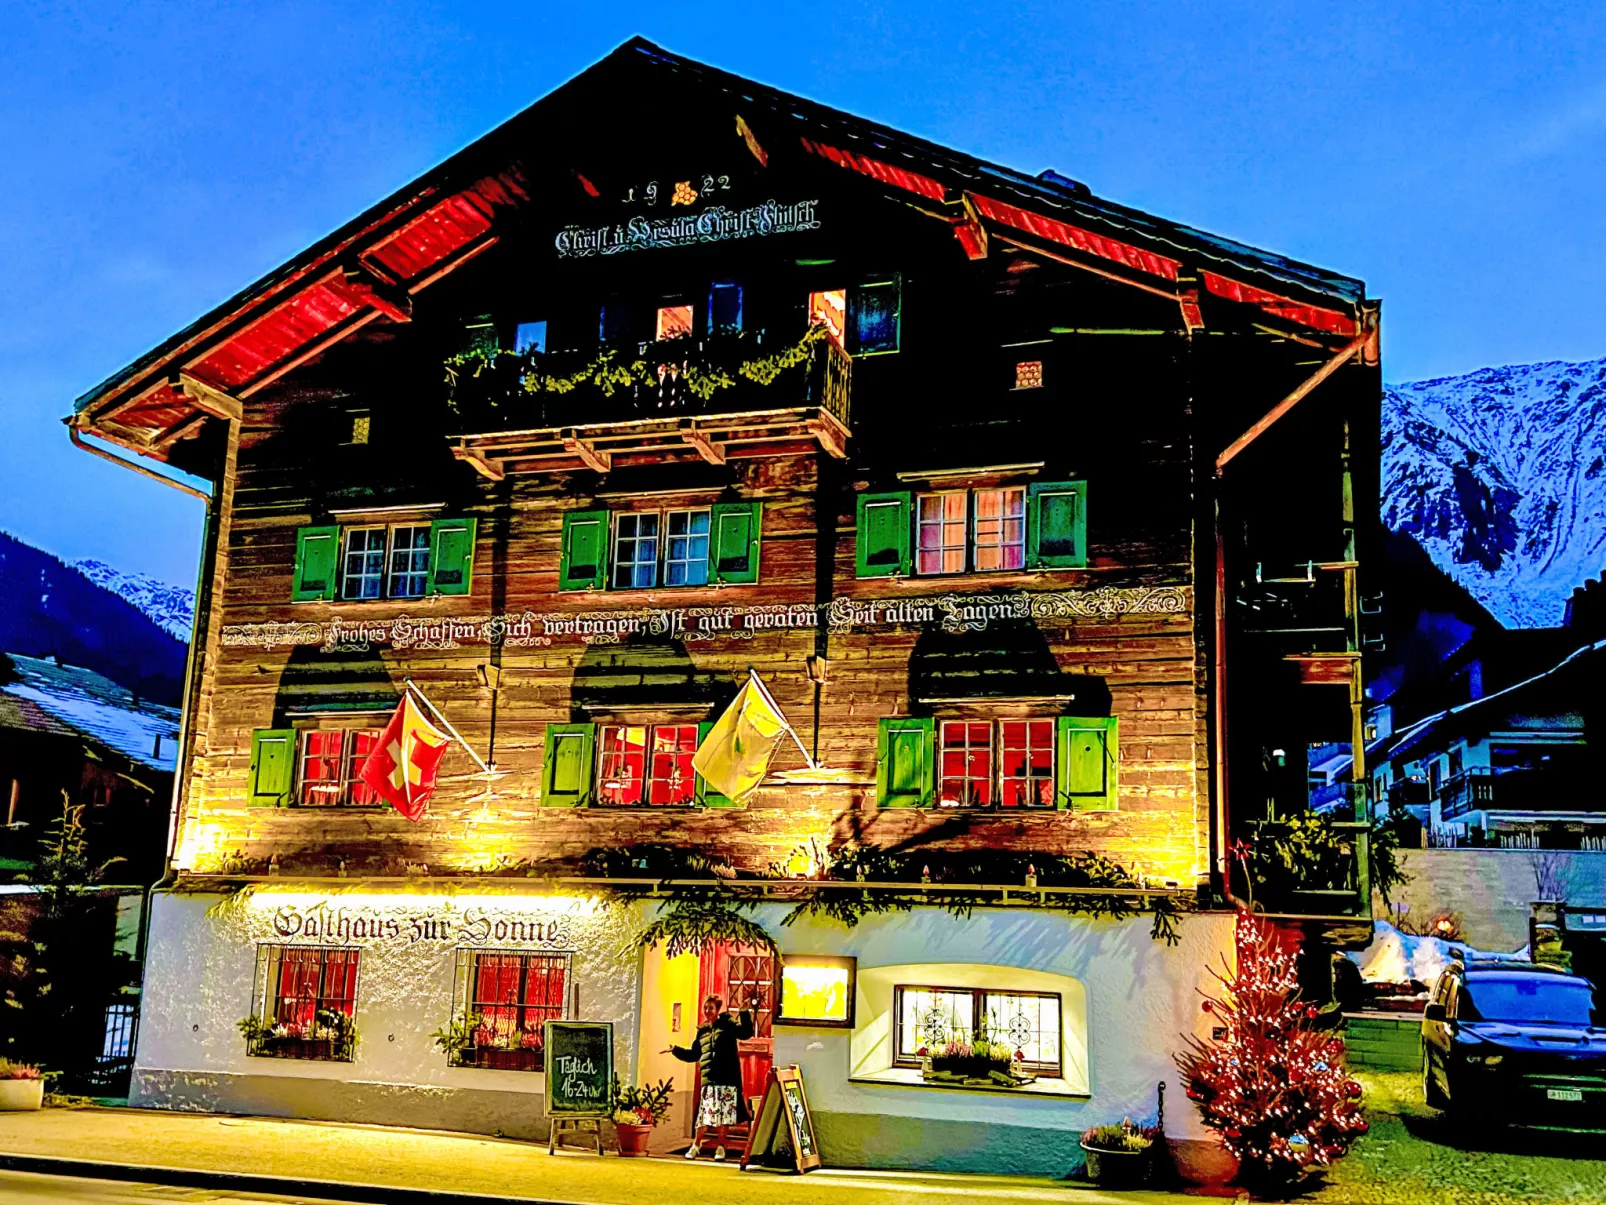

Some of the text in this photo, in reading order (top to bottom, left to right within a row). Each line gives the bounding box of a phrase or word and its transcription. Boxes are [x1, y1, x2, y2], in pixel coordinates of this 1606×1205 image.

[324, 617, 387, 651] Frohes
[698, 612, 734, 640] gut
[743, 606, 819, 638] geraten
[828, 598, 879, 633] Seit
[884, 603, 935, 623] alten
[457, 908, 568, 947] Sonne
